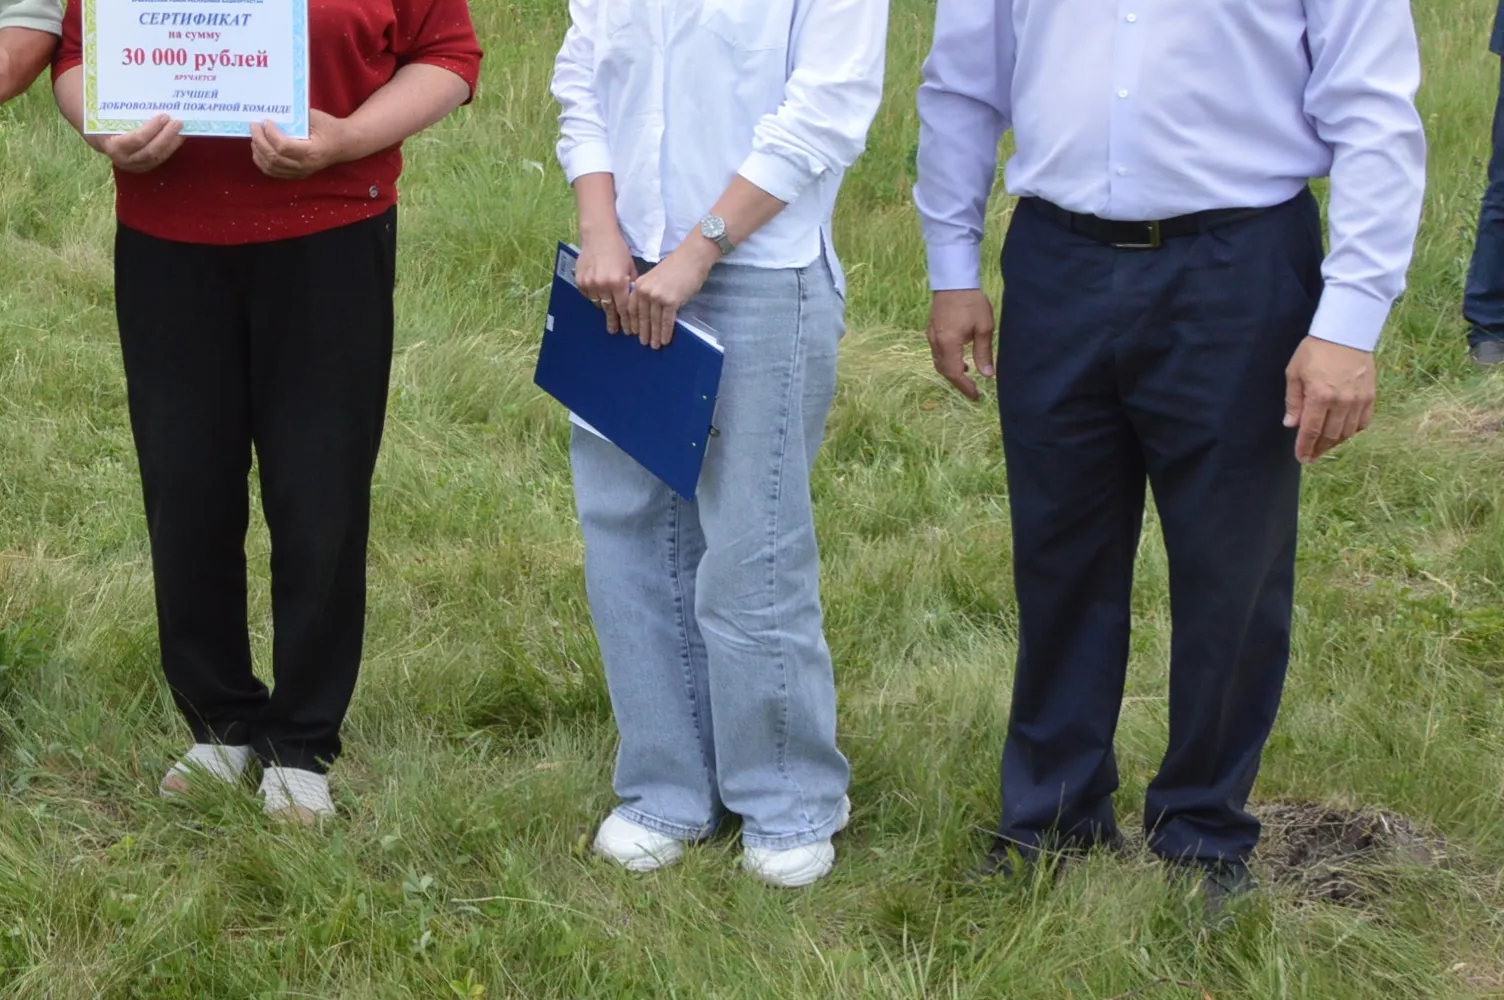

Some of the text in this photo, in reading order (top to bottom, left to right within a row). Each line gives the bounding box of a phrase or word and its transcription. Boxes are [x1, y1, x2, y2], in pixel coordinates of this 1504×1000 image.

[139, 12, 252, 27] СЕРТИФИКАТ
[168, 30, 221, 42] на сумму
[121, 48, 269, 71] 30 000 рублей
[172, 89, 219, 99] ЛУЧШЕЙ
[99, 101, 292, 114] ДОБРОВОЛЬНОЙ ПОЖАРНОЙ КОМАНДЕ
